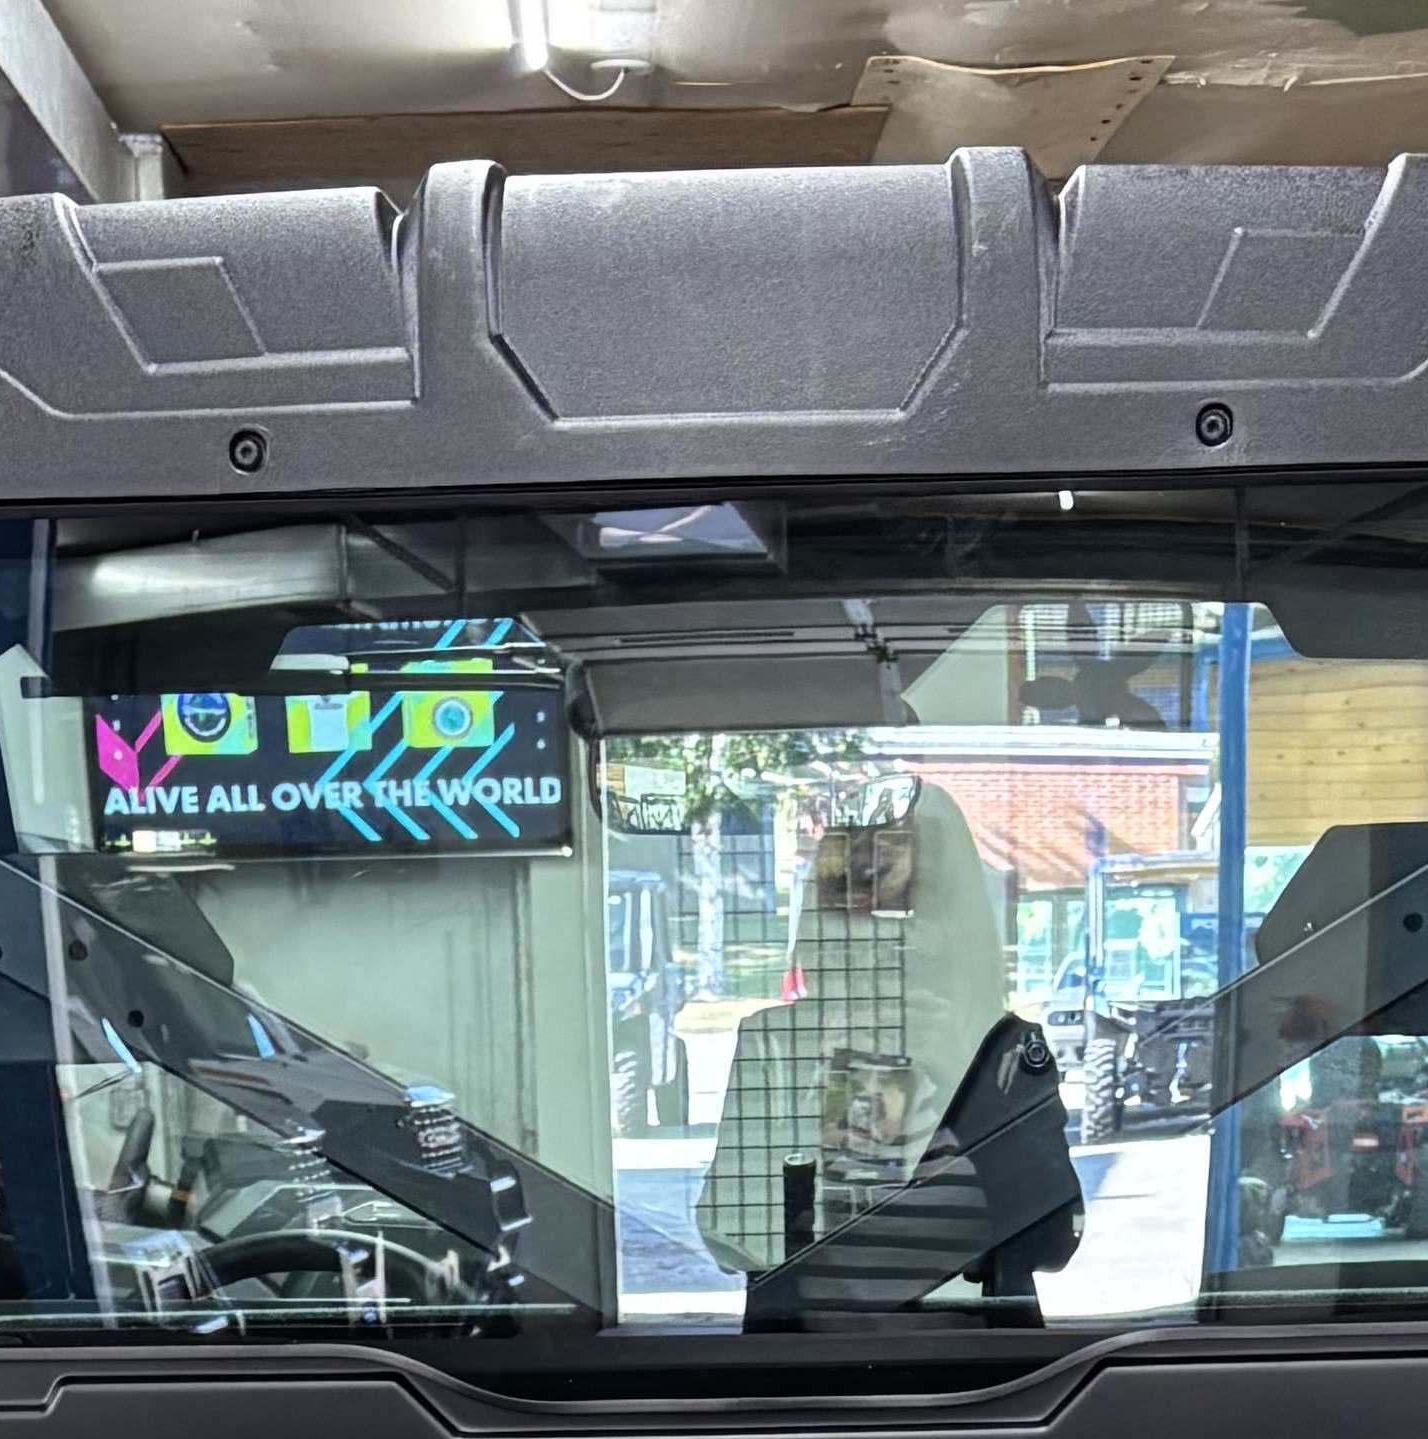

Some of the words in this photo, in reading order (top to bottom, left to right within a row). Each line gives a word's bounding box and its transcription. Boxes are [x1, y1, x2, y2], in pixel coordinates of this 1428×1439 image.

[103, 785, 200, 815] ALIVE
[205, 784, 267, 813] ALL
[271, 780, 365, 812] OVER
[372, 777, 432, 808] THE
[436, 775, 562, 806] WORLD
